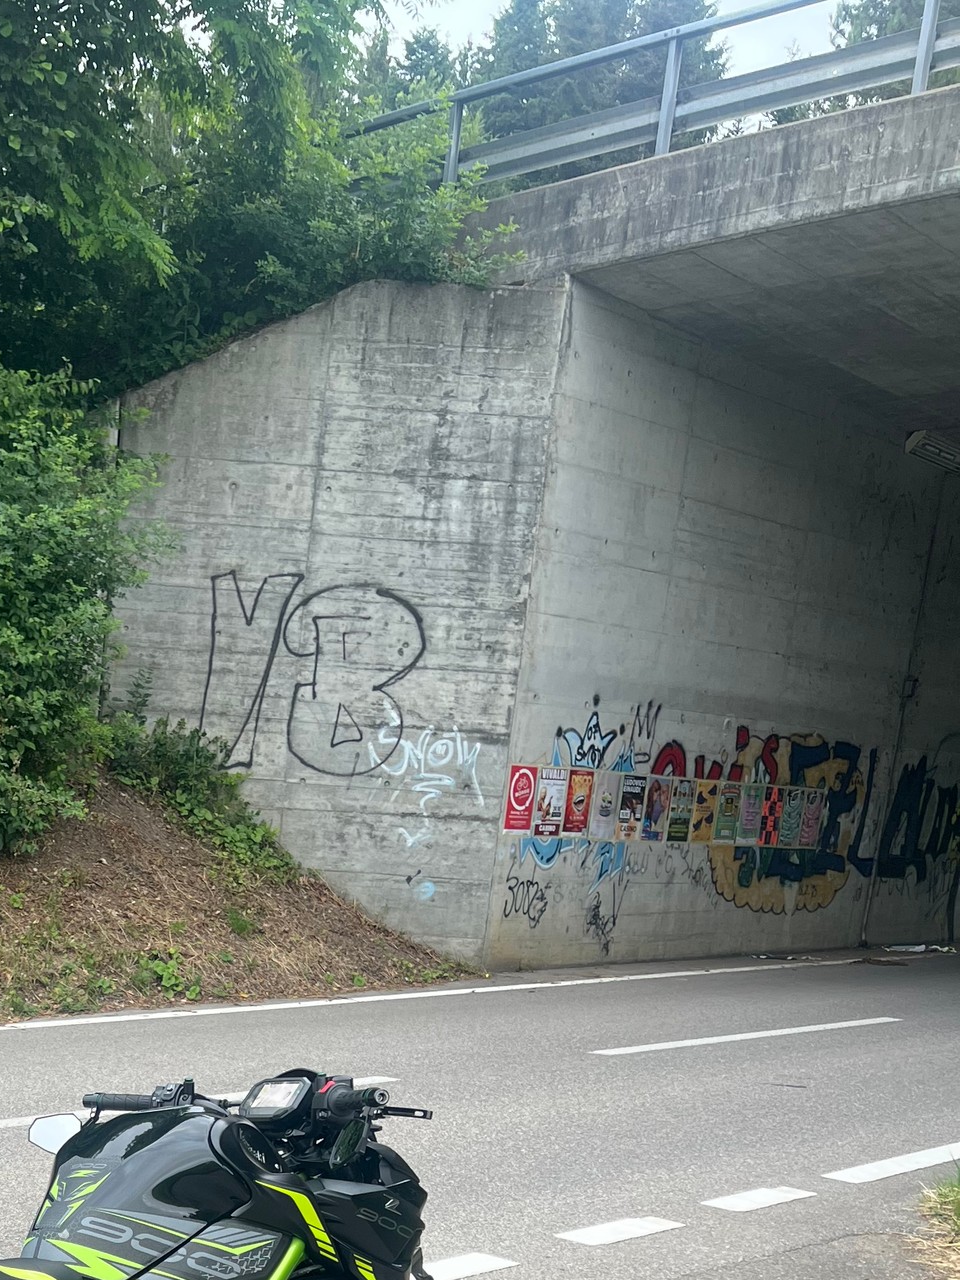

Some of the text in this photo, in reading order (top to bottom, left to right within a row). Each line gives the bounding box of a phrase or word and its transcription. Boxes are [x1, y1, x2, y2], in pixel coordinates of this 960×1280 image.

[542, 768, 567, 781] VIVALDI
[356, 1207, 414, 1239] 900
[77, 1216, 241, 1280] 900
